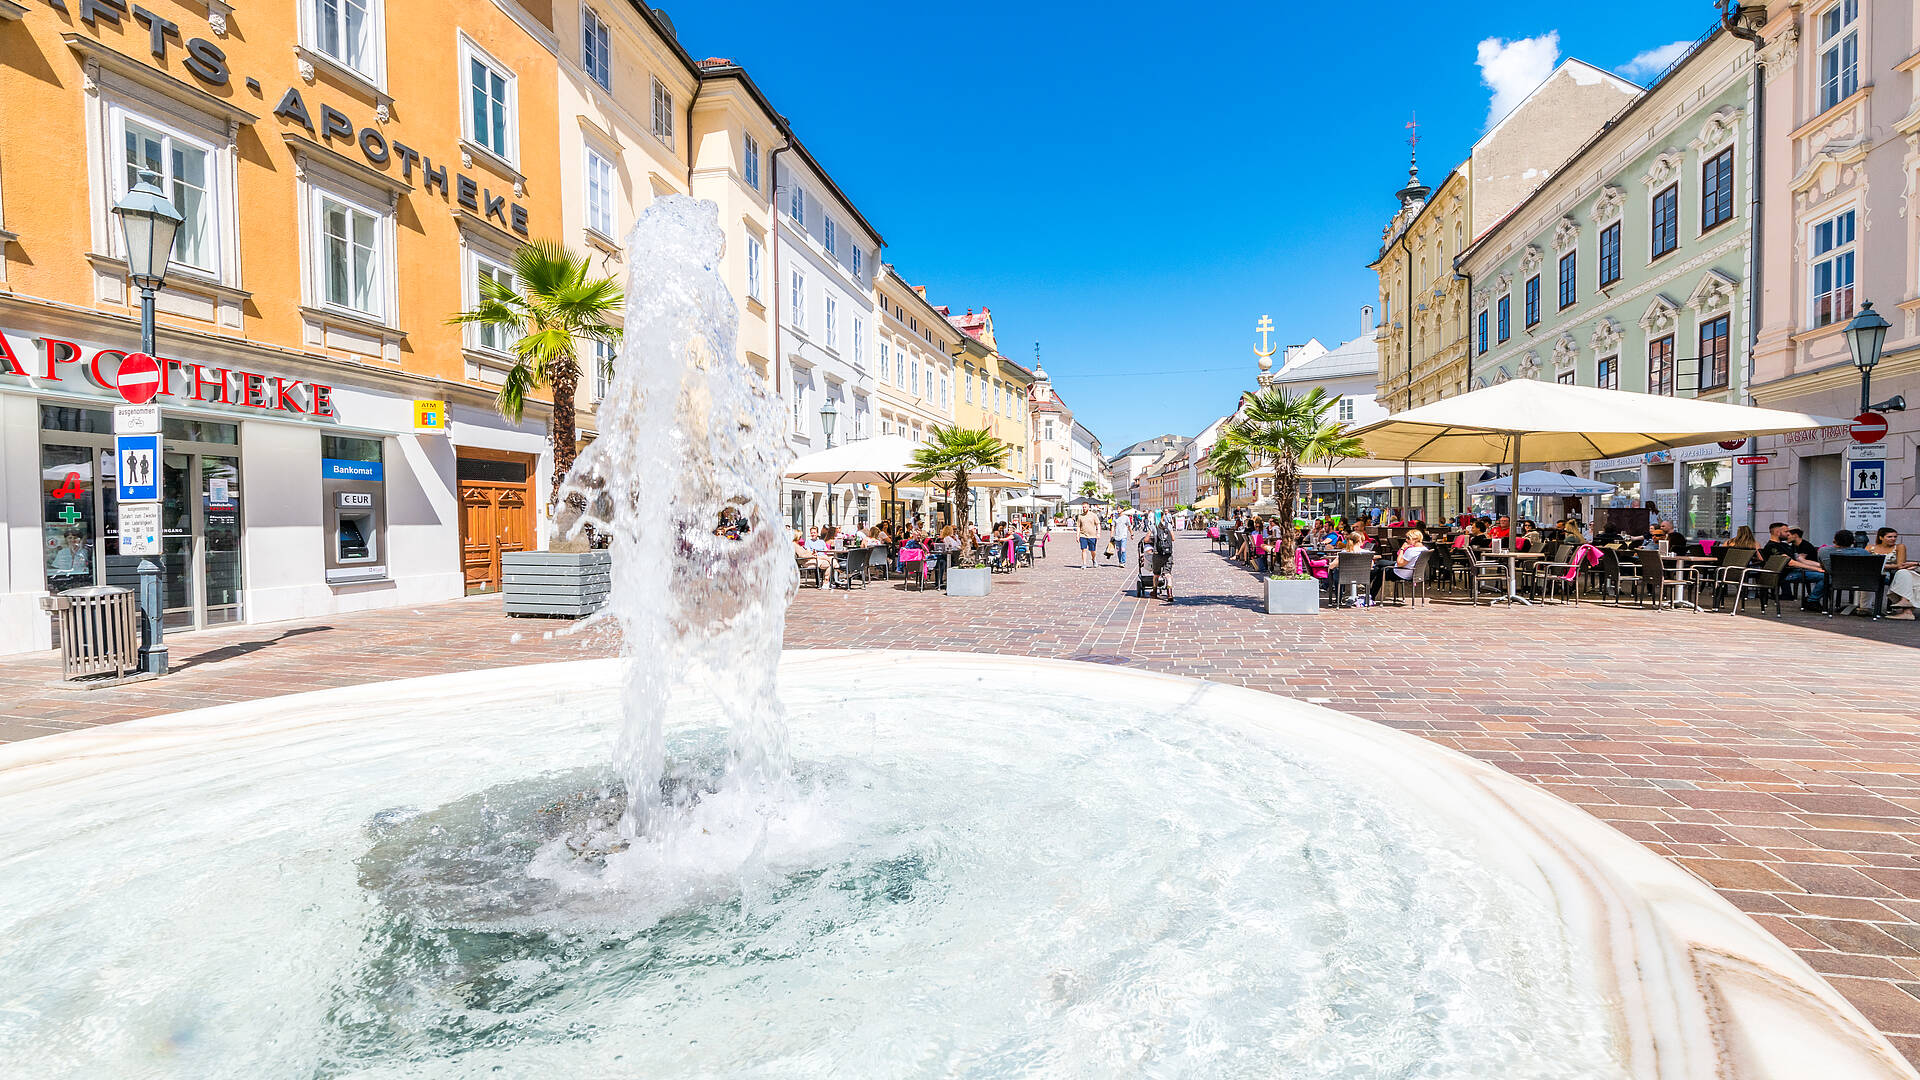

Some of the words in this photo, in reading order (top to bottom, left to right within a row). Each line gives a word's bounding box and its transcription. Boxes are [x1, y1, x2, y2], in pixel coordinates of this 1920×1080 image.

[50, 0, 230, 86] FTS
[273, 87, 528, 236] APOTHEKE
[118, 408, 156, 417] ausgenommen
[333, 465, 373, 475] Bankomat
[352, 496, 369, 504] EUR
